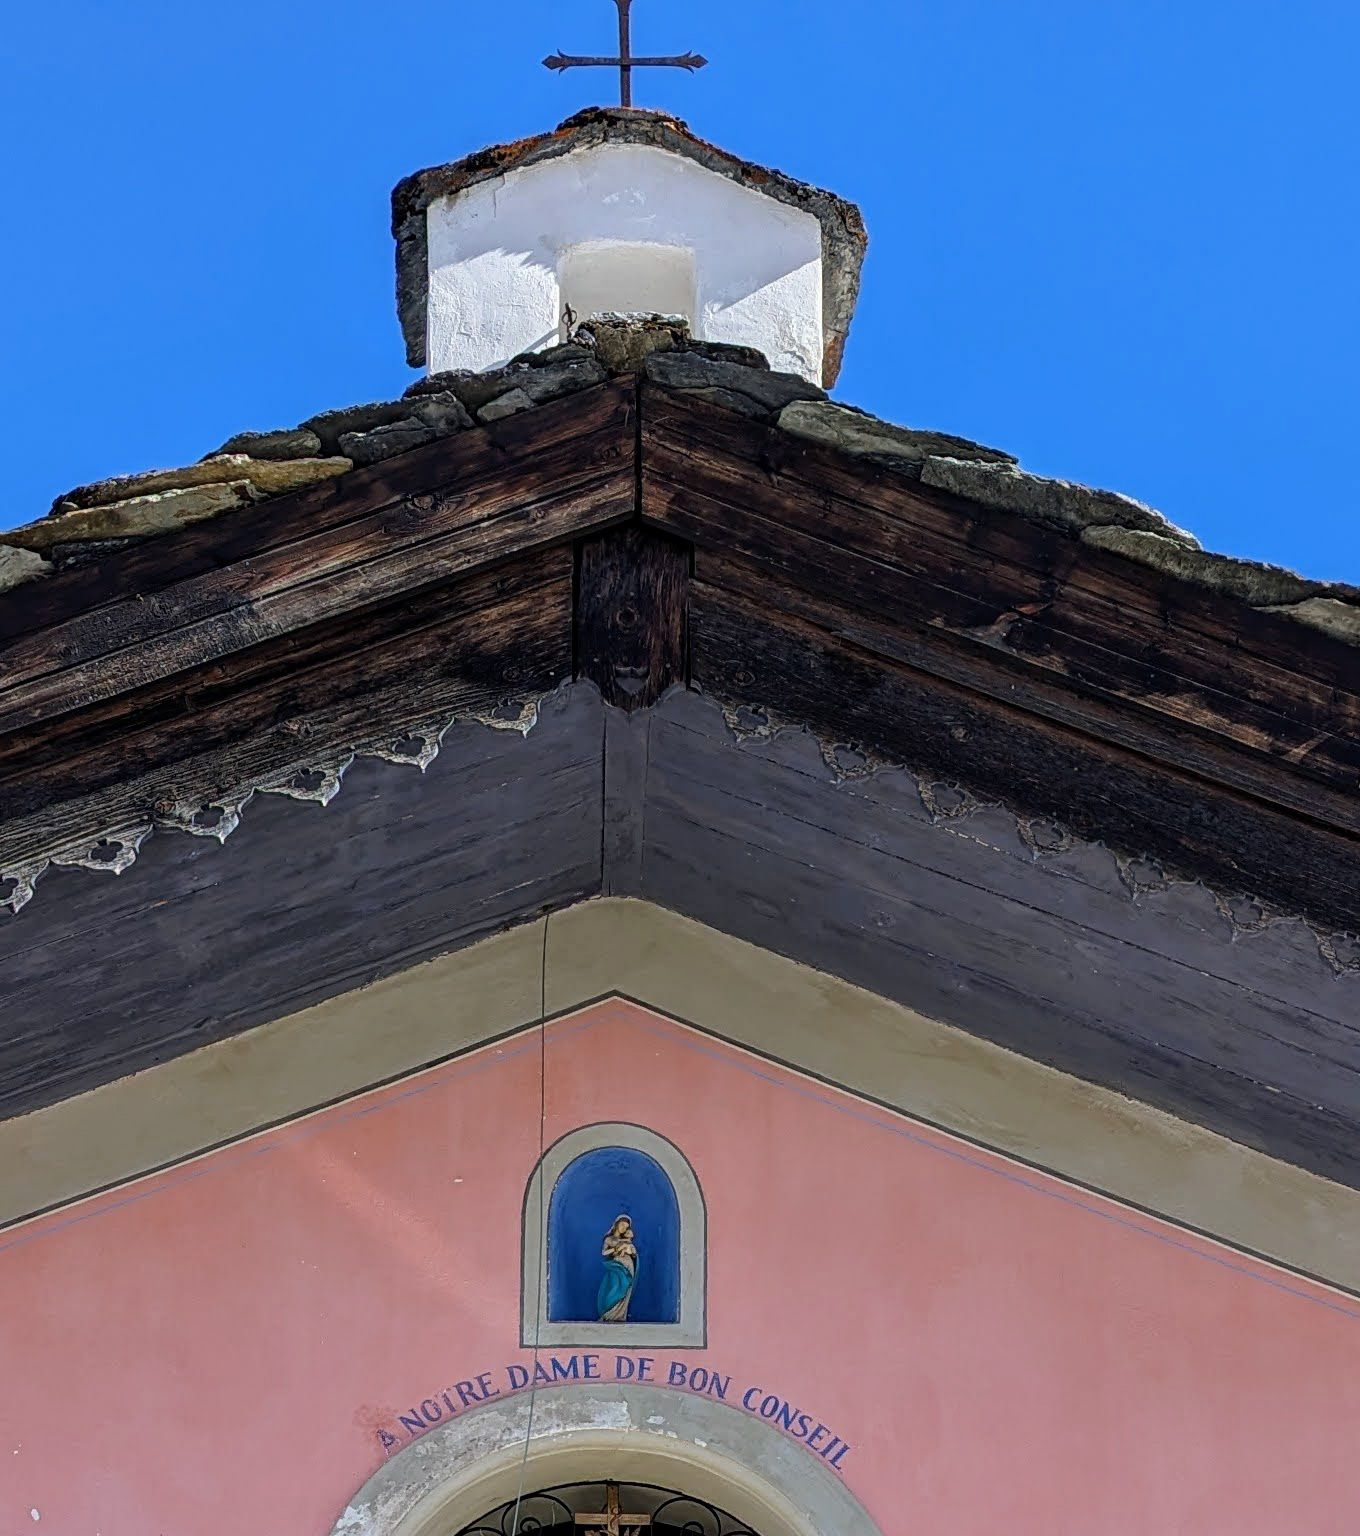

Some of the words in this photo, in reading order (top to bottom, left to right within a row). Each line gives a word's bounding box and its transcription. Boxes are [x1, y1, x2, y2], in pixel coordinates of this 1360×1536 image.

[399, 1371, 501, 1436] NOTRE
[506, 1354, 602, 1390] DAME
[615, 1355, 655, 1382] DE
[667, 1361, 733, 1400] BON
[742, 1387, 851, 1471] CONSEIL
